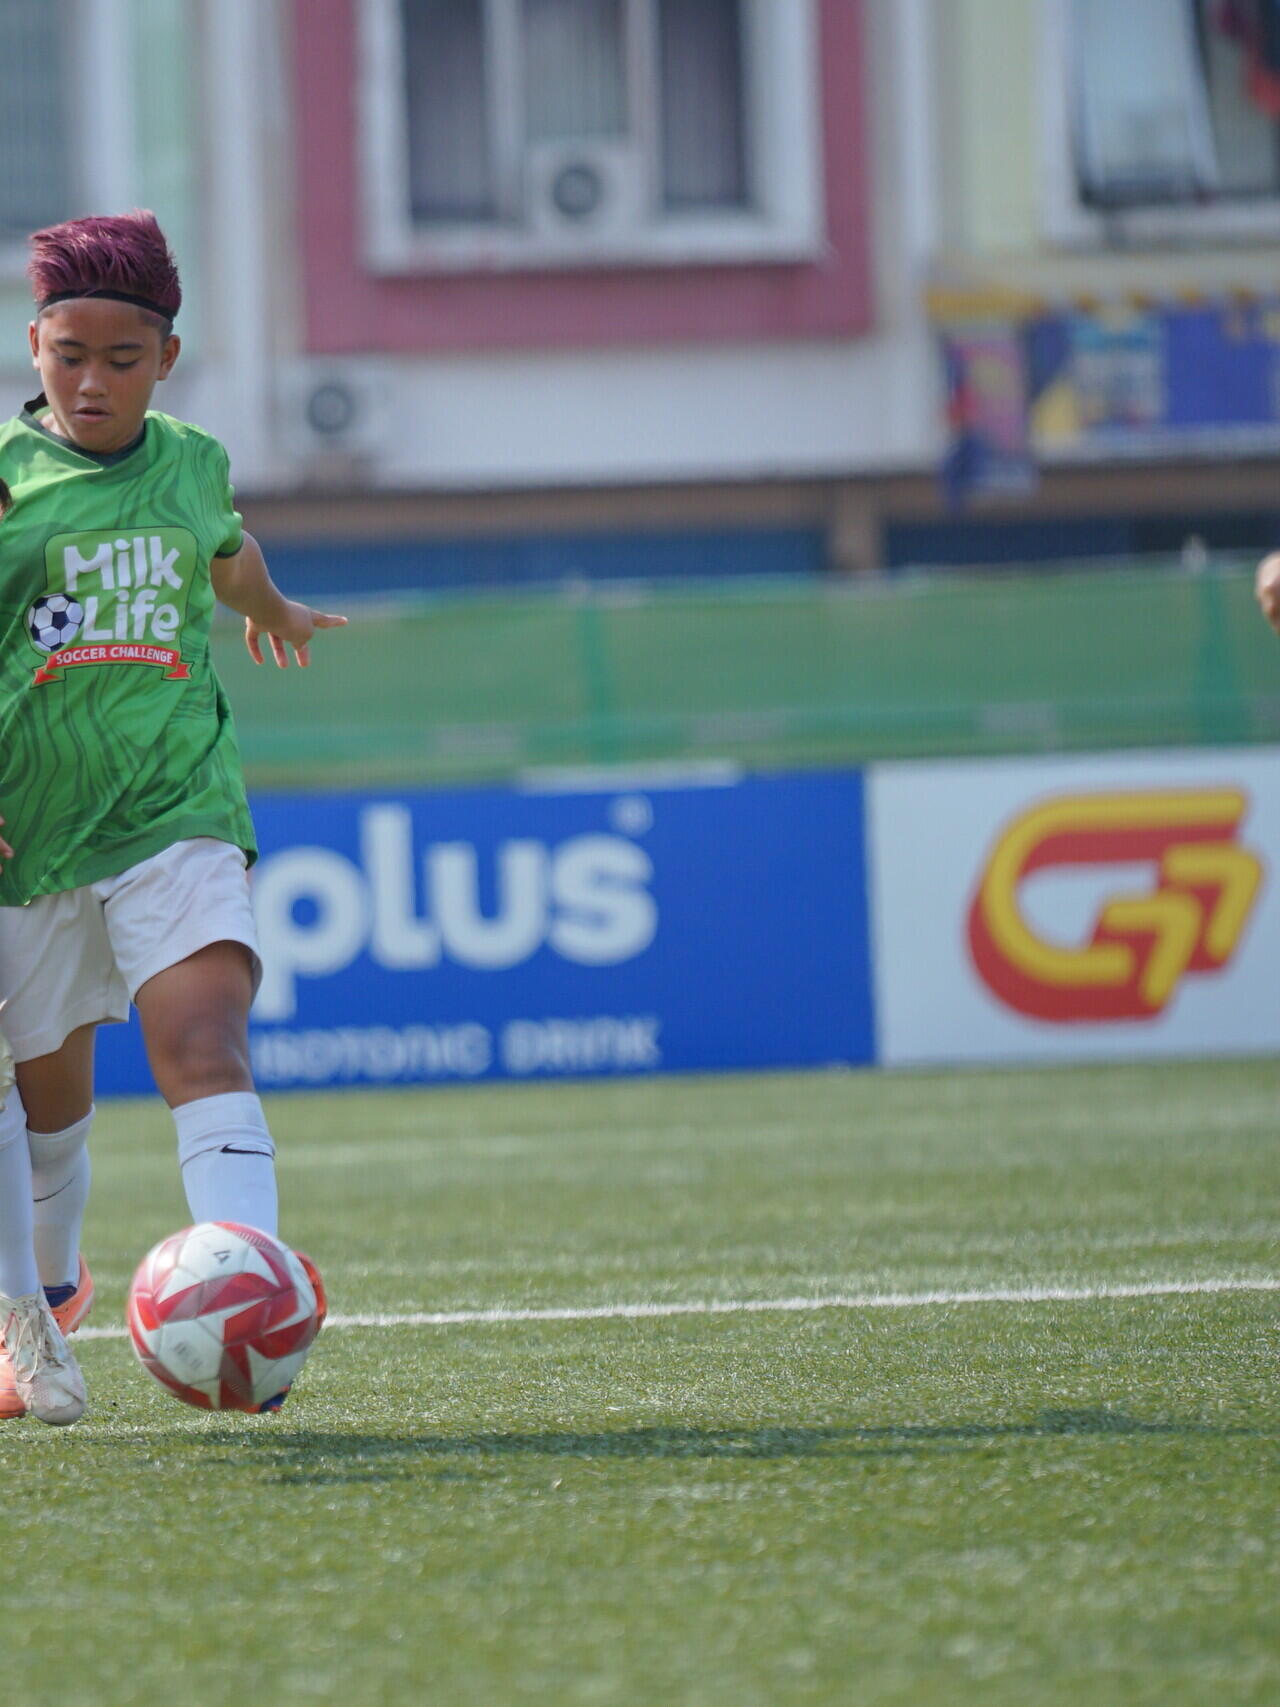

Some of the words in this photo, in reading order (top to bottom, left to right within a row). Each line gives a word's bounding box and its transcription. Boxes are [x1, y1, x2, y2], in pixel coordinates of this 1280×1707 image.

[63, 536, 183, 592] Milk
[81, 589, 180, 641] Life
[56, 647, 107, 665] SOCCER
[110, 646, 174, 664] CHALLENGE
